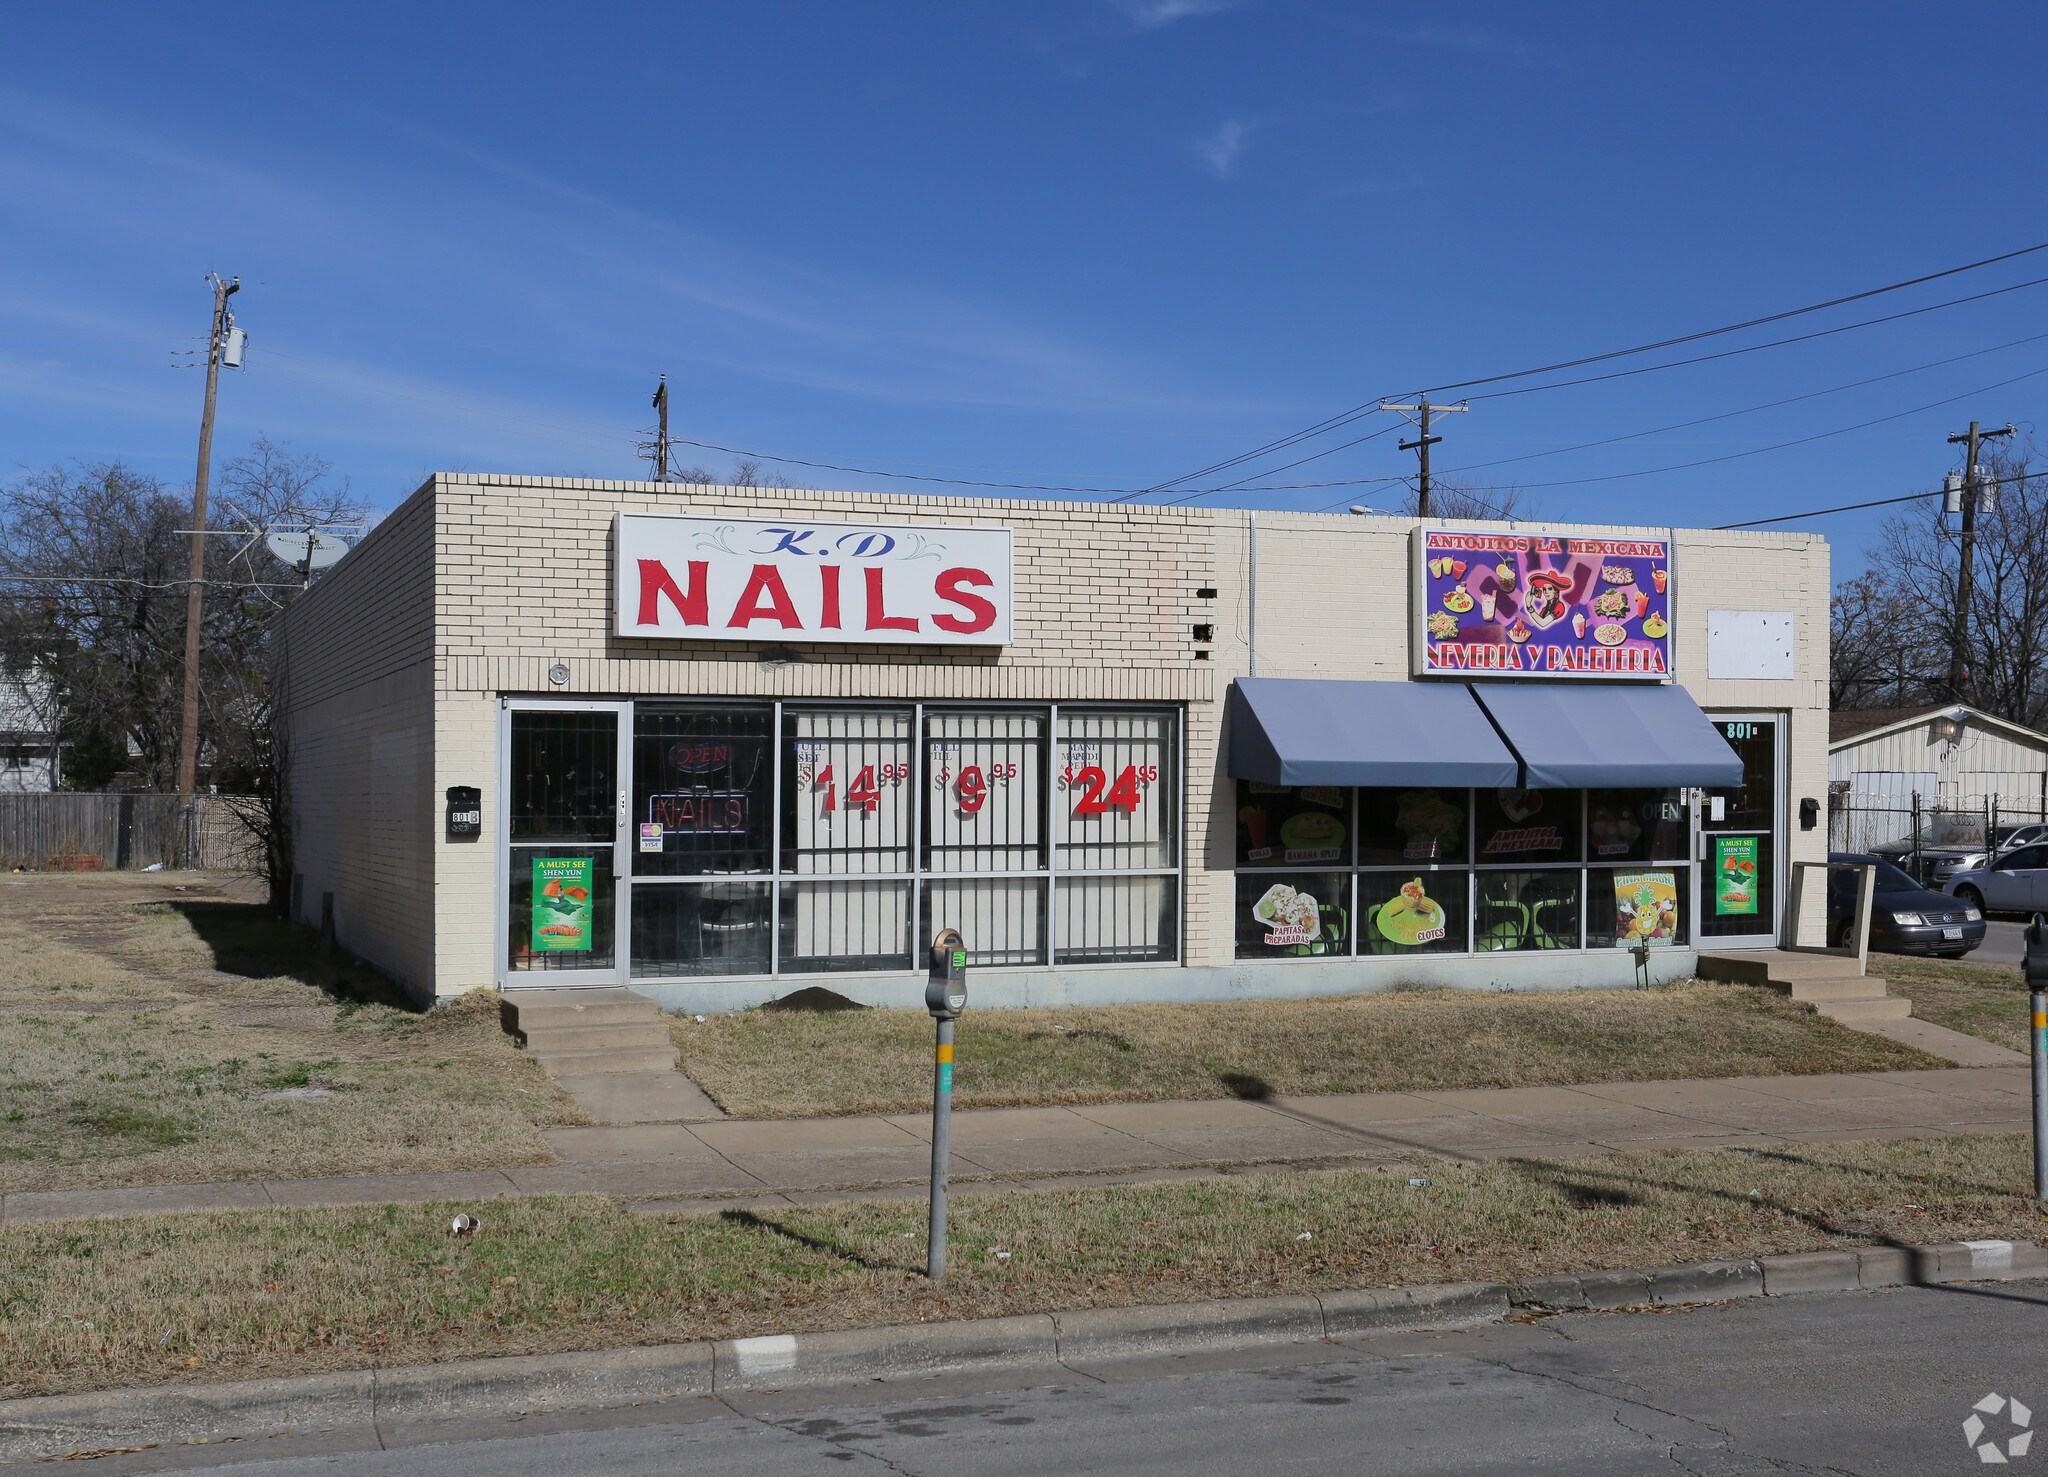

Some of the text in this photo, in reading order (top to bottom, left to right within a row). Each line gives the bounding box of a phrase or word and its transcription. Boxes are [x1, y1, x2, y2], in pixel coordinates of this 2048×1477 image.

[749, 527, 895, 557] K.D
[1428, 535, 1664, 556] ANTOJITOS LA MEXICANA
[636, 558, 997, 634] NAILS
[1427, 644, 1665, 672] NEVERIA Y PALETERIA
[1727, 722, 1751, 739] 801
[793, 741, 826, 751] FULL
[933, 743, 960, 752] FILL
[676, 745, 729, 765] OPEN
[798, 753, 821, 763] SET
[657, 798, 742, 829] NAILS
[1641, 802, 1679, 820] OPEN
[1493, 827, 1555, 841] ANTOJITOS
[1500, 838, 1562, 851] MEXICANA
[1287, 849, 1339, 860] BANANA SPLIT
[572, 860, 586, 868] SEE
[1274, 926, 1303, 935] PAPITAS
[1418, 928, 1444, 941] ELOTES
[1265, 935, 1310, 944] PREPARADAS
